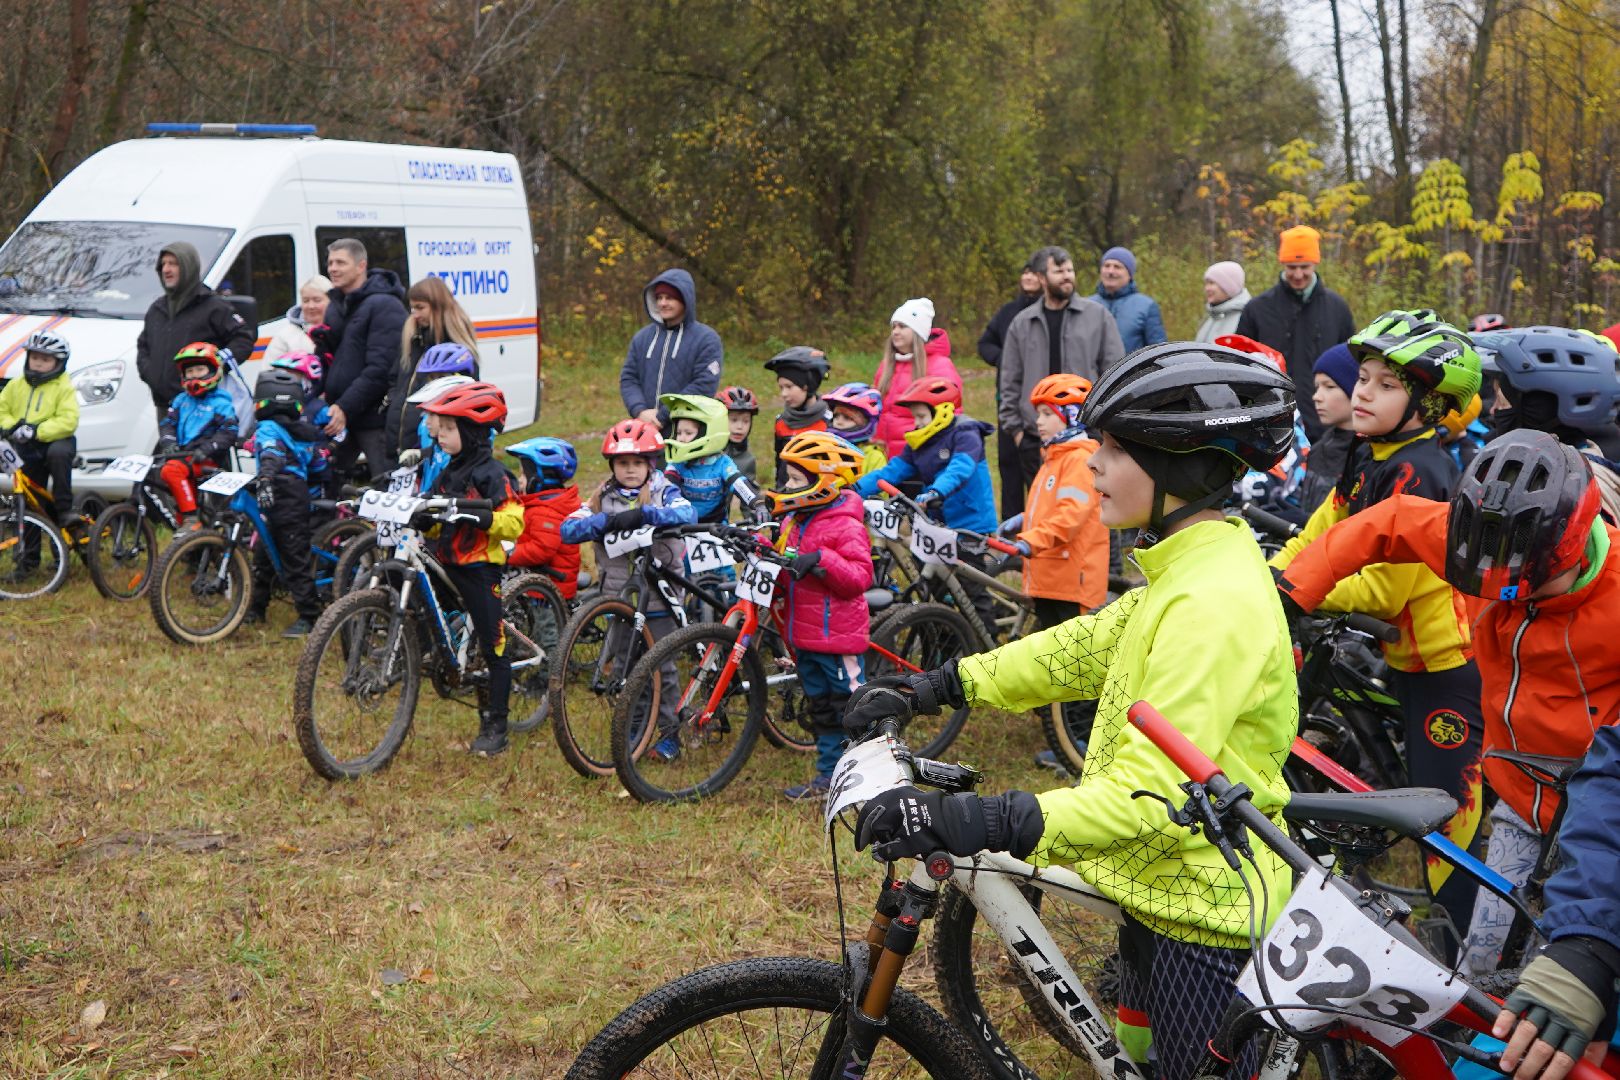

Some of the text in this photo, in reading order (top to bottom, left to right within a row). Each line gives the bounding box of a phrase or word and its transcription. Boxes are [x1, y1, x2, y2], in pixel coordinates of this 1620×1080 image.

[408, 160, 513, 183] СПАСАТЕЛЬНАЯ СЛУЖБА
[418, 239, 511, 255] ГОРОДСКОЙ ОКРУГ
[428, 270, 509, 295] ТУПИНО
[1204, 415, 1252, 427] ROCKBROS
[914, 528, 954, 559] 194
[1267, 907, 1431, 1027] 323
